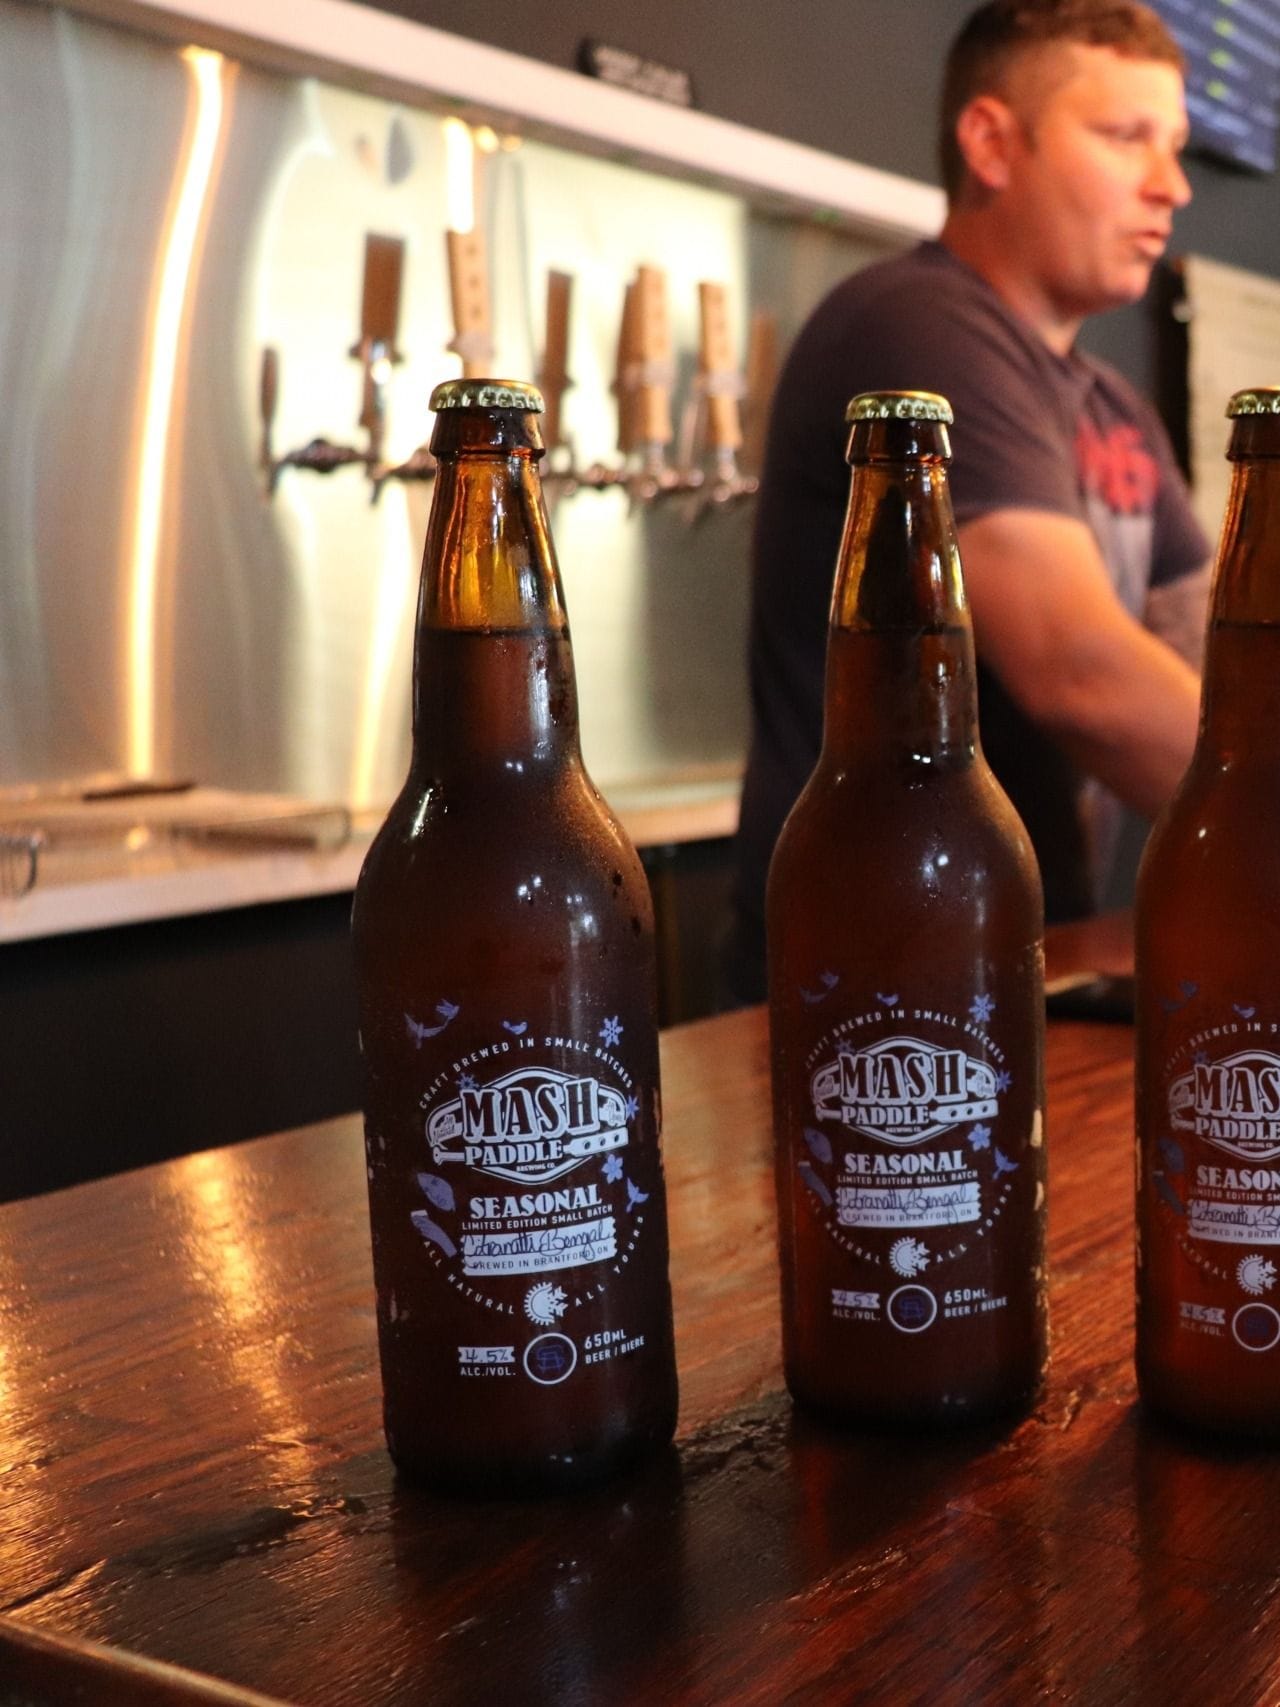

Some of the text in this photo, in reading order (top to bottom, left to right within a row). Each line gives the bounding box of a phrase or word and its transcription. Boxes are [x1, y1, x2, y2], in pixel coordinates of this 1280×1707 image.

[832, 1011, 881, 1037] BREWED
[890, 1010, 905, 1019] IN
[914, 1010, 957, 1027] SMALL
[964, 1022, 1005, 1063] BATCHES
[1247, 1022, 1261, 1032] IN
[419, 1037, 633, 1109] CRAFT BREWED IN SMALL BATCHES
[839, 1050, 968, 1105] MASH
[460, 1078, 600, 1143] MASH
[841, 1105, 930, 1125] PADDLE
[465, 1140, 564, 1165] PADDLE
[844, 1150, 968, 1175] SEASONAL
[837, 1169, 978, 1186] LIMITED EDITION SMALL BATCH
[469, 1184, 603, 1219] SEASONAL
[1226, 1190, 1263, 1200] EDITION
[462, 1204, 613, 1231] LIMITED EDITION SMALL BATCH
[886, 1213, 896, 1222] IN
[960, 1208, 972, 1217] ON
[937, 1184, 1012, 1263] ALL YOURS
[520, 1258, 529, 1268] IN
[597, 1245, 609, 1255] ON
[574, 1216, 644, 1307] ALL YOURS
[423, 1240, 514, 1315] ALL NATURAL
[944, 1288, 988, 1304] 650ML
[944, 1305, 971, 1318] BEER
[584, 1329, 627, 1350] 650ML
[585, 1350, 611, 1364] BEER
